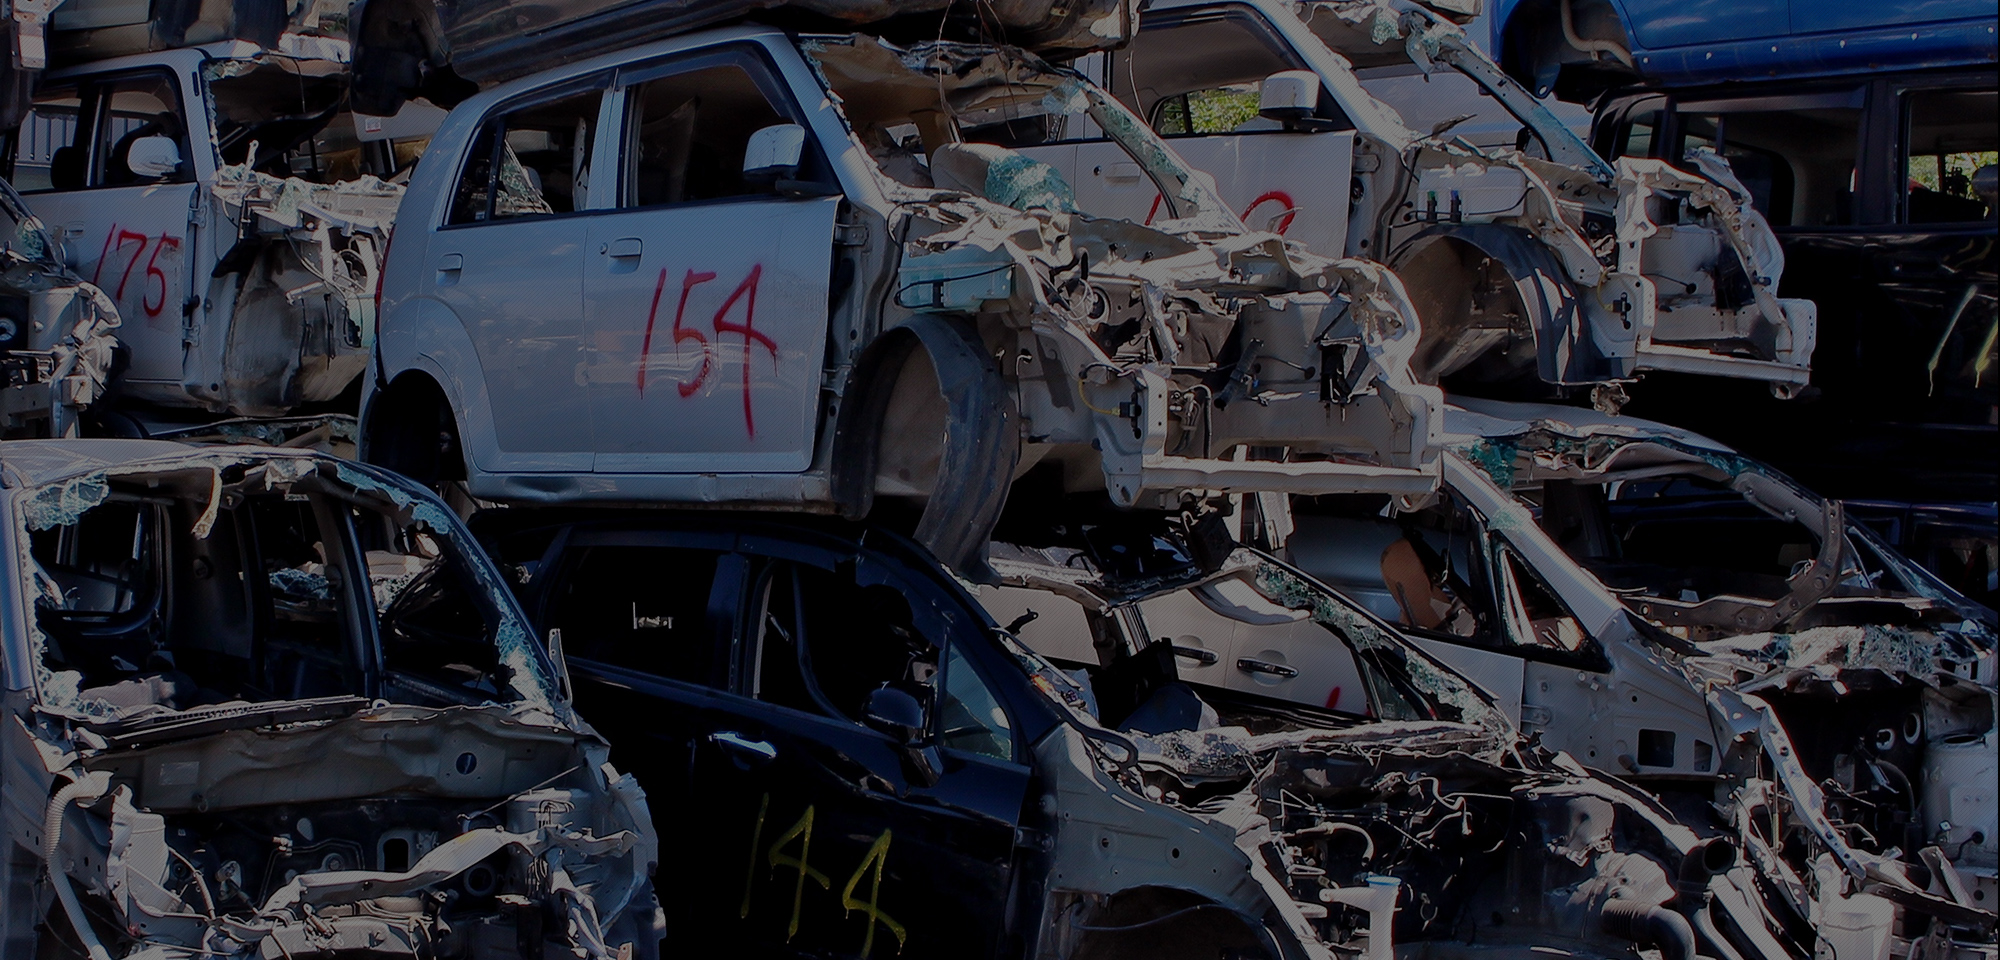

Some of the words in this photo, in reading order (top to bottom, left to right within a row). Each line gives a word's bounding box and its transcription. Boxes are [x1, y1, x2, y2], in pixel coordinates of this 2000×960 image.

[93, 223, 179, 317] 175
[638, 263, 778, 438] 154
[740, 791, 907, 960] 144
